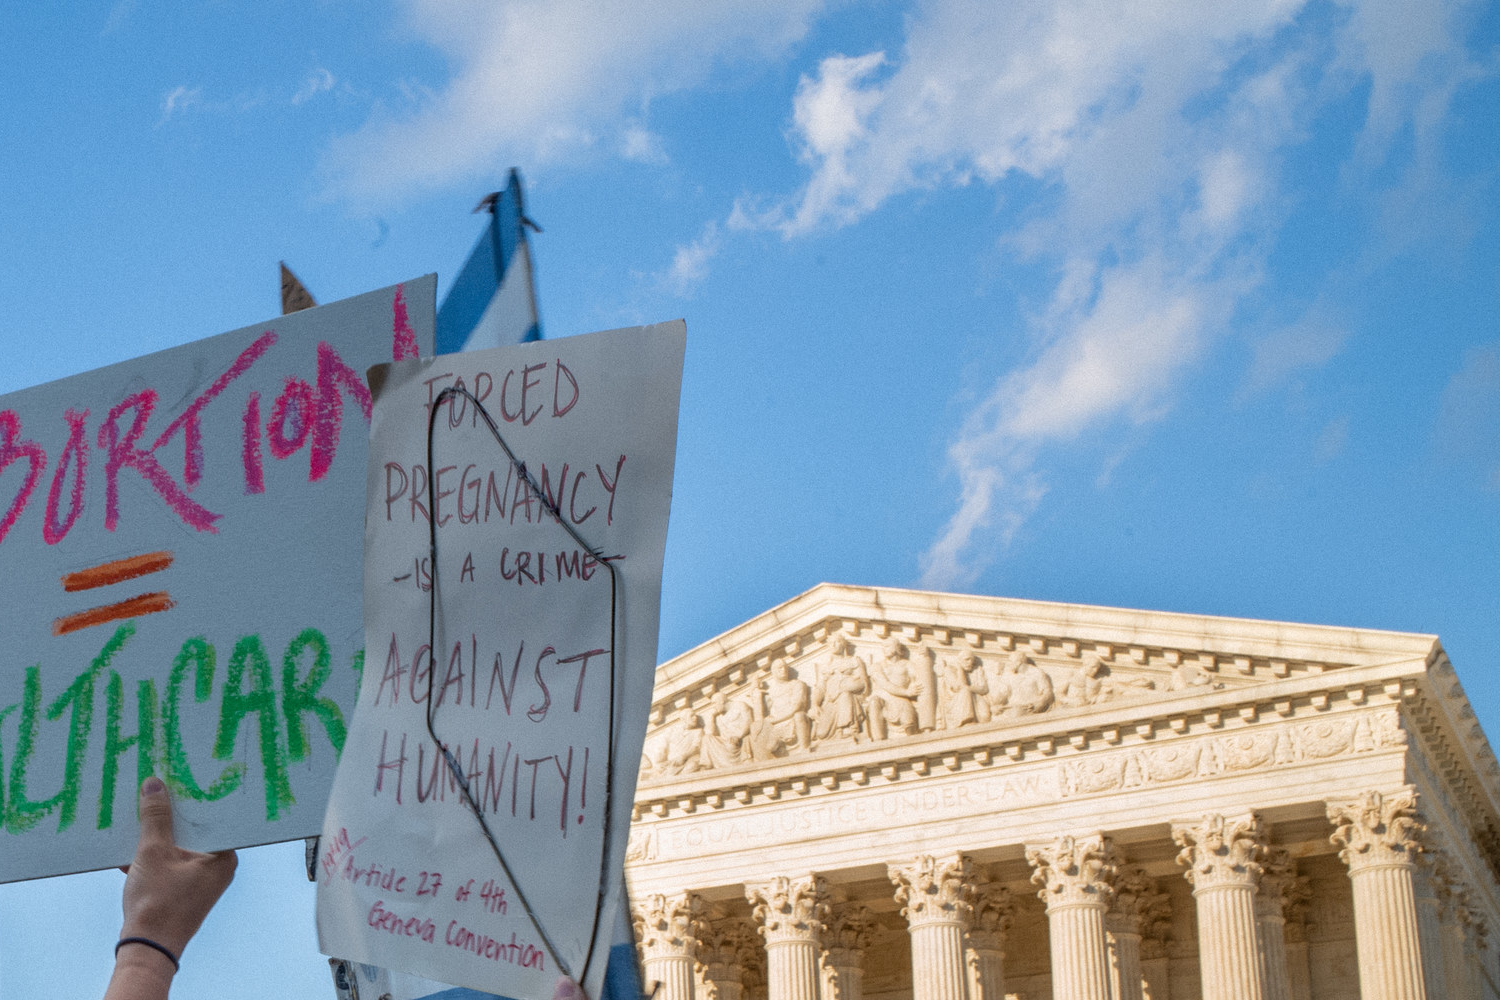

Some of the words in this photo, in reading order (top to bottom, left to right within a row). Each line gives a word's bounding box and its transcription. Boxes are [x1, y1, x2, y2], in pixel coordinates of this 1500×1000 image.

[423, 359, 580, 431] FORCED
[385, 454, 627, 528] PREGNANCY
[460, 560, 476, 583] A
[374, 632, 611, 723] AGAINST
[374, 730, 591, 838] HUMANITY!
[672, 821, 759, 850] EQUAL
[765, 801, 868, 838] JUSTICE
[880, 785, 971, 817] UNDER
[985, 774, 1042, 802] LAW
[342, 853, 407, 893] Article
[416, 871, 443, 897] 27
[455, 879, 476, 902] of
[367, 900, 436, 944] Geneva
[445, 919, 545, 971] Convention
